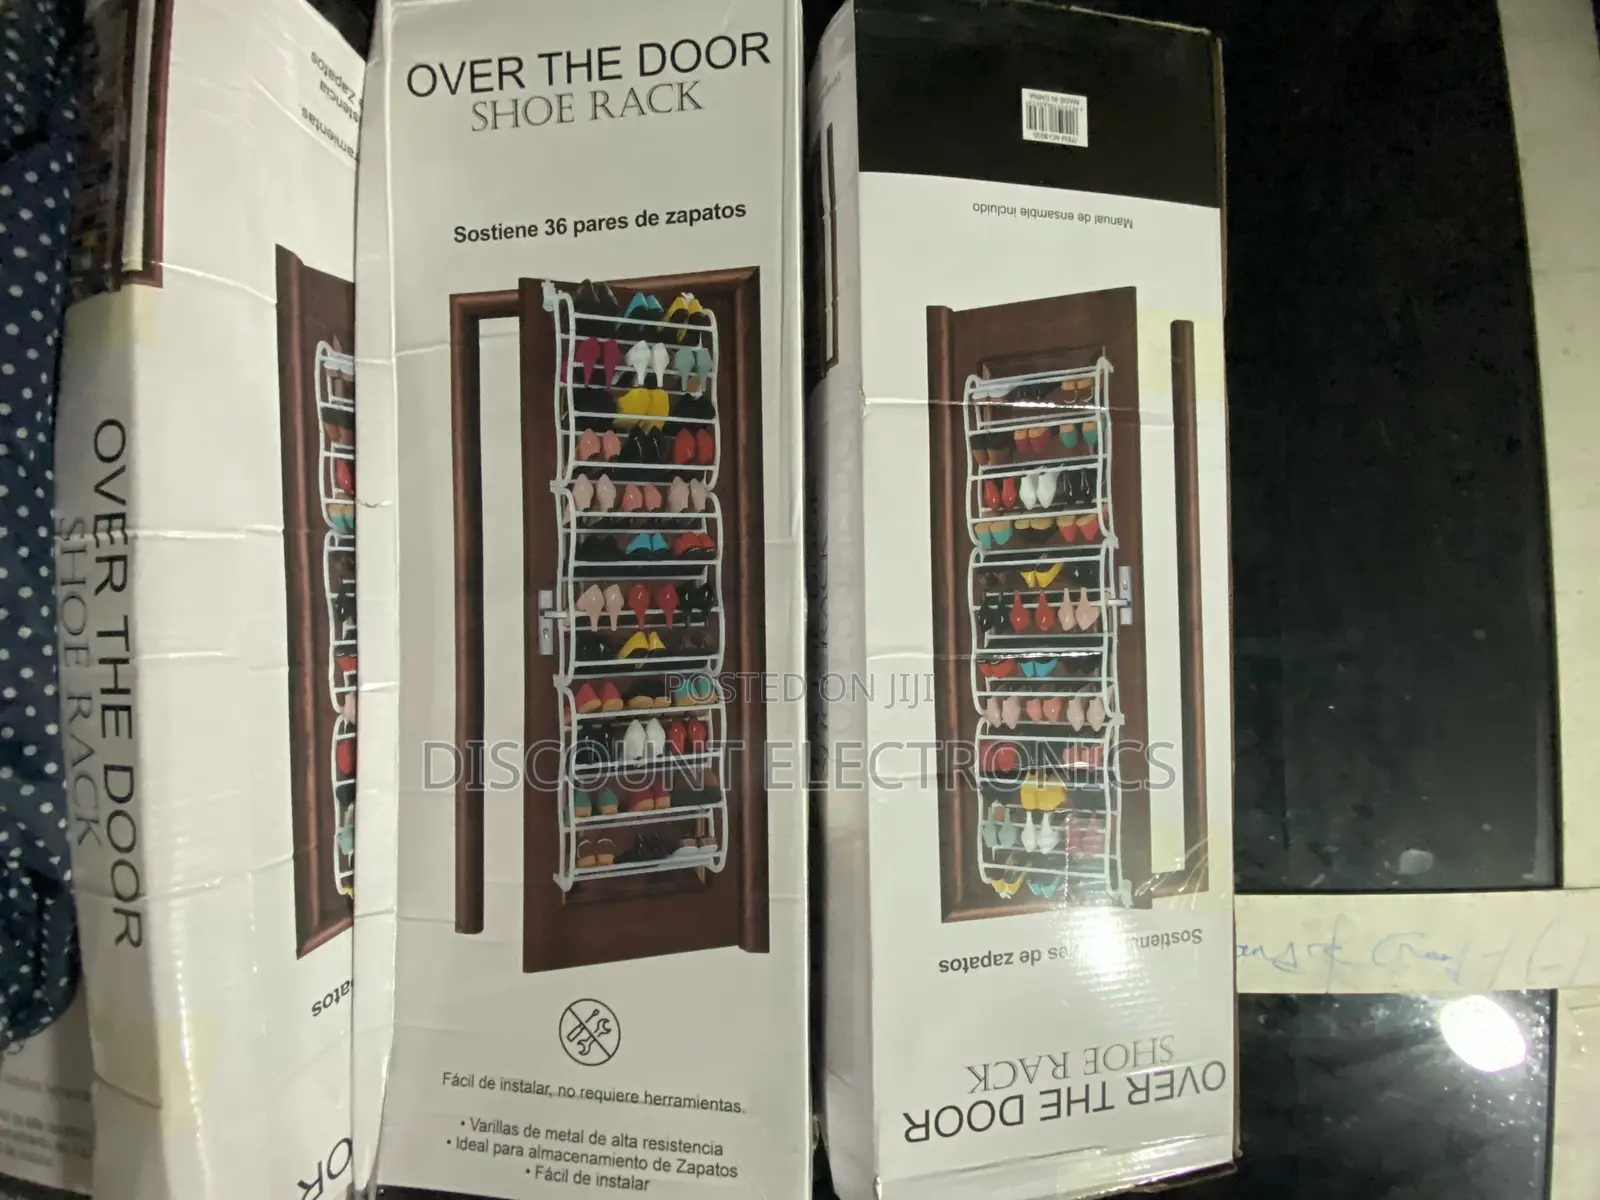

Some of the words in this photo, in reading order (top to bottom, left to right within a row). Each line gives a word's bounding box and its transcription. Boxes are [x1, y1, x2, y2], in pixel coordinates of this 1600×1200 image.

[406, 55, 526, 99] OVER
[537, 45, 623, 87] THE
[638, 31, 772, 78] DOOR
[470, 92, 575, 133] SHOE
[589, 80, 706, 121] RACK
[453, 222, 539, 244] Sostiene
[544, 218, 568, 237] 36
[573, 214, 629, 238] pares
[634, 209, 660, 228] de
[664, 201, 747, 227] zapatos
[972, 202, 1018, 217] incluido
[1019, 204, 1075, 222] ensamble
[1077, 210, 1092, 225] de
[1094, 212, 1134, 230] Manual
[93, 418, 129, 598] OVER
[58, 515, 90, 669] SHOE
[96, 614, 133, 741] THE
[66, 689, 102, 847] RACK
[102, 763, 144, 950] DOOR
[938, 950, 1014, 974] zapatos
[1019, 948, 1042, 967] de
[311, 979, 353, 1017] atos
[964, 1051, 1070, 1094] RACK
[1083, 1034, 1176, 1077] SHOE
[442, 1071, 475, 1088] Fácil
[478, 1074, 496, 1091] de
[558, 1083, 576, 1099] no
[580, 1085, 640, 1108] requiere
[643, 1090, 747, 1114] herramientas.
[1039, 1080, 1115, 1123] THE
[1126, 1060, 1227, 1106] OVER
[470, 1117, 520, 1137] Varillas
[523, 1121, 541, 1139] de
[544, 1125, 584, 1145] metal
[588, 1128, 607, 1147] de
[610, 1132, 638, 1150] alta
[642, 1134, 724, 1157] resistencia
[902, 1093, 1025, 1144] DOOR
[455, 1135, 489, 1153] Ideal
[492, 1141, 524, 1160] para
[528, 1143, 648, 1171] almacenamiento
[652, 1154, 672, 1174] de
[675, 1157, 739, 1180] Zapatos
[535, 1164, 568, 1184] Fácil
[572, 1167, 592, 1186] de
[595, 1170, 651, 1192] instalar
